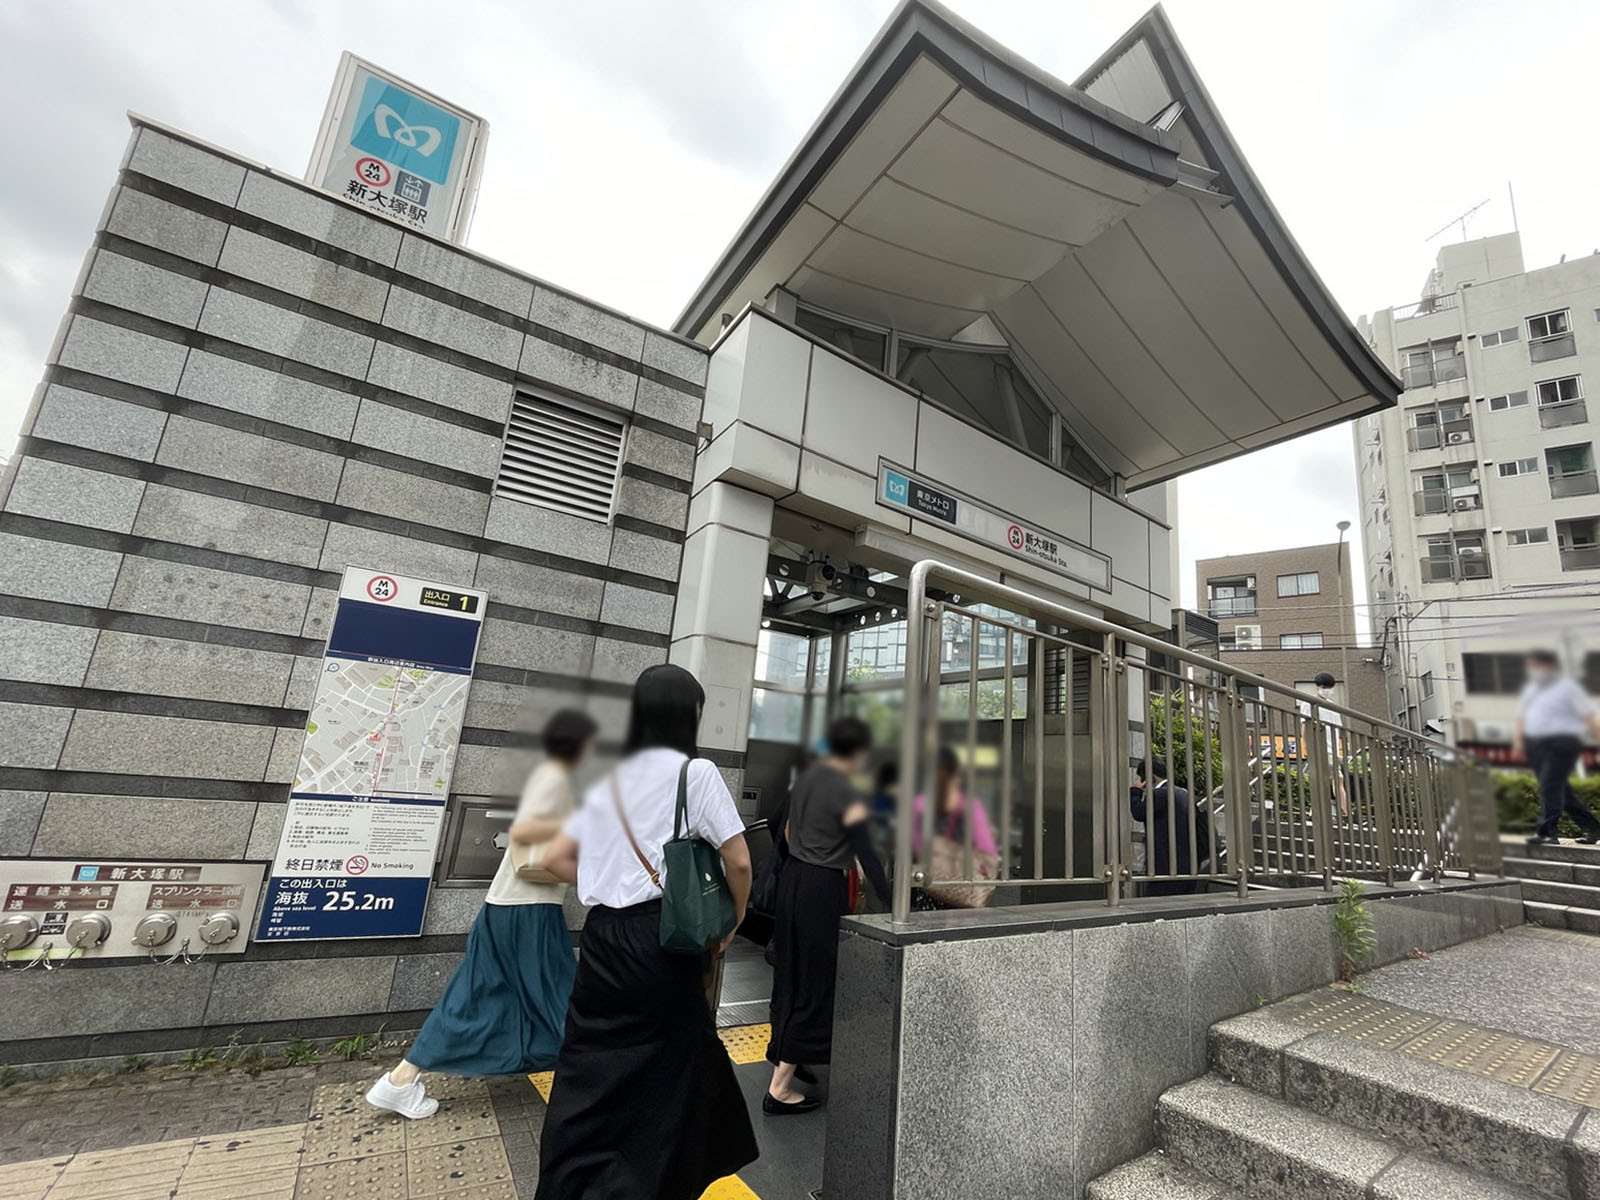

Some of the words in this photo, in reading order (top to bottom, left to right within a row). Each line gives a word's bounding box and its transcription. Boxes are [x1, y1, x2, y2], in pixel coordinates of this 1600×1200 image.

[369, 163, 380, 172] M
[365, 169, 380, 181] 24
[346, 179, 428, 224] 新大塚駅
[916, 489, 950, 511] 東京メトロ
[1011, 535, 1020, 545] 24
[1025, 532, 1058, 556] 新大塚駅
[1025, 544, 1058, 564] Shin-otsuka
[378, 579, 389, 588] M
[374, 587, 389, 597] 24
[424, 589, 451, 602] 出入口
[423, 598, 449, 608] Entrance
[459, 596, 469, 611] 1
[284, 858, 344, 872] 終日禁煙
[383, 862, 414, 871] Smoking
[109, 867, 185, 881] 新大塚駅
[278, 878, 348, 890] この出入口は
[12, 885, 114, 897] 連結送水管
[7, 899, 109, 911] 送水口
[274, 891, 310, 906] 海抜
[321, 890, 396, 912] 25.2m
